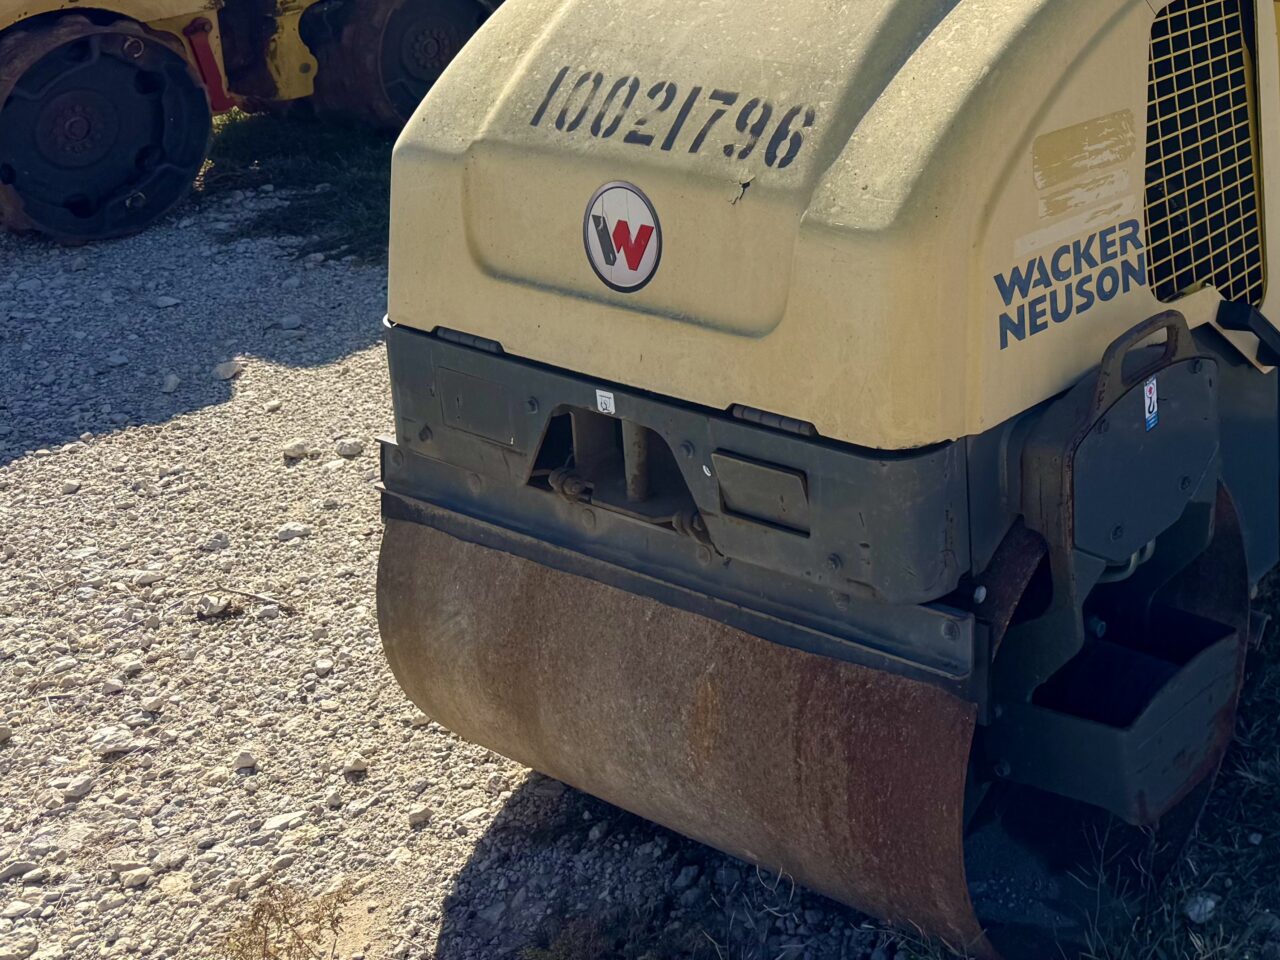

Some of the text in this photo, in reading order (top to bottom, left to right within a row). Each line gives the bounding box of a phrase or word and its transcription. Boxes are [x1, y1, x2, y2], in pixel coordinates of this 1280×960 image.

[529, 65, 816, 169] 10021796
[993, 218, 1144, 307] WACKER
[999, 251, 1146, 351] NEUSON
